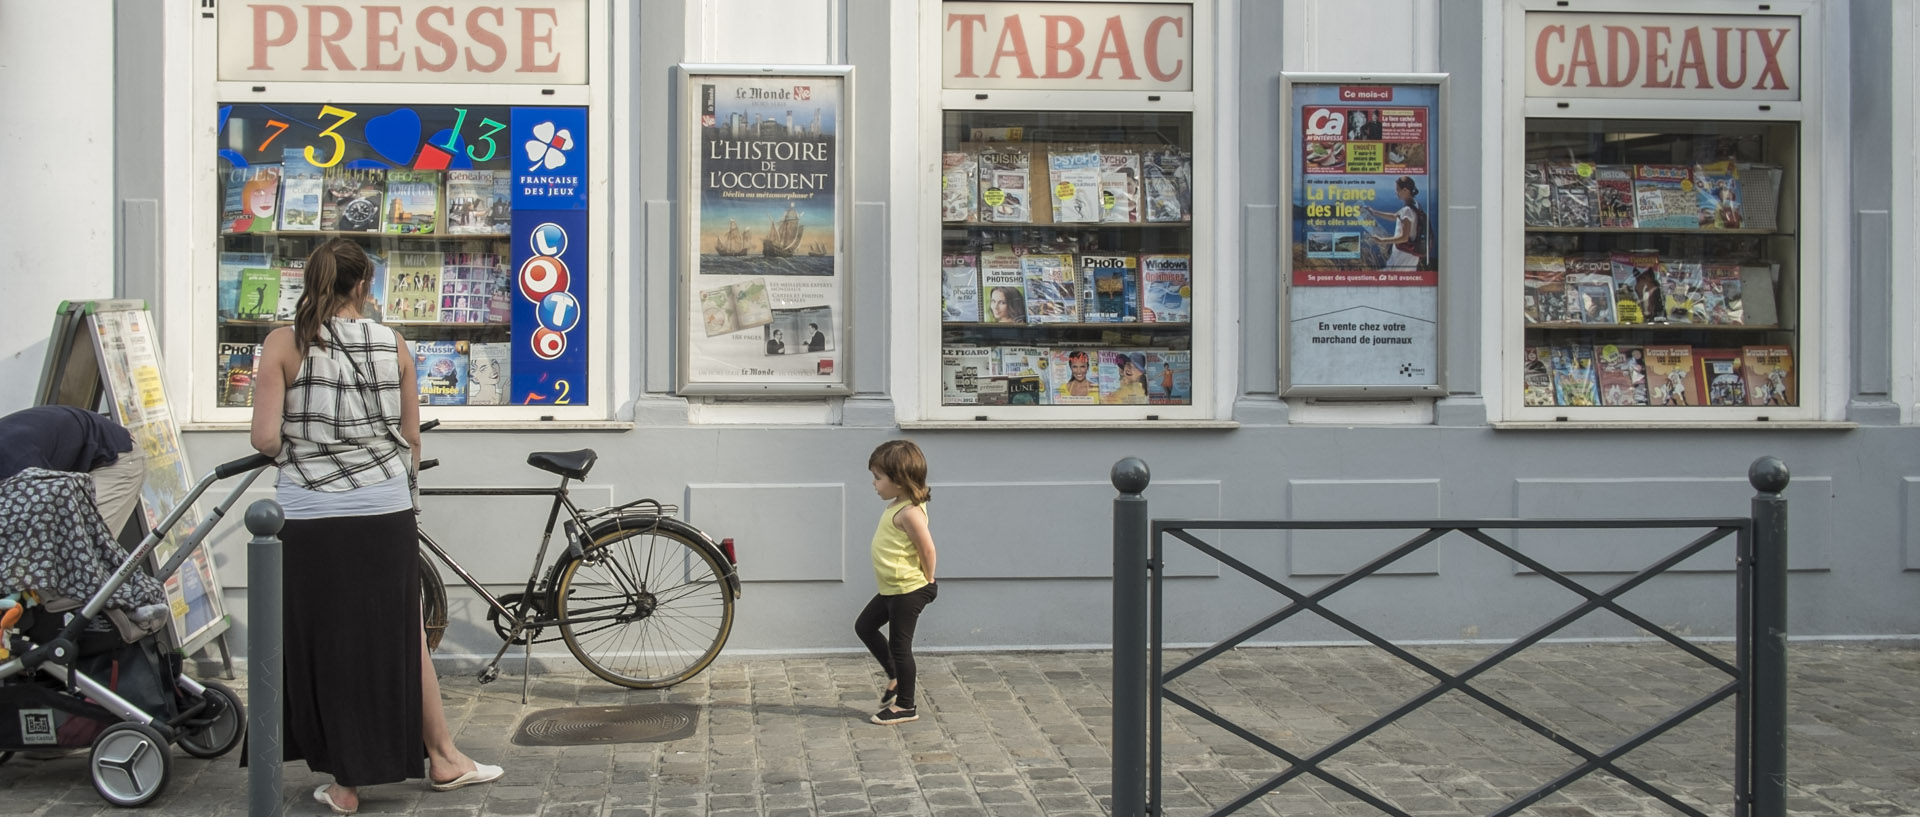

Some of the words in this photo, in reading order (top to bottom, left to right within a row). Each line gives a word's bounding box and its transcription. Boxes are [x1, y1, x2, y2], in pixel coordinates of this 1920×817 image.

[247, 4, 561, 73] PRESSE
[947, 13, 1183, 82] TABAC
[1535, 24, 1791, 90] CADEAUX
[736, 87, 747, 100] Le
[750, 87, 791, 100] Monde
[1344, 90, 1356, 98] Ce
[1358, 90, 1388, 98] mois-ci
[258, 120, 290, 152] 7
[304, 105, 357, 168] 3
[710, 140, 828, 161] L'HISTOIRE
[983, 154, 1029, 165] CUISINE
[1099, 156, 1128, 164] SYCHO
[761, 161, 776, 171] DE
[449, 171, 492, 185] Généalog
[710, 171, 828, 190] L'OCCIDENT
[524, 187, 544, 195] DES
[548, 187, 574, 196] JEUX
[723, 190, 745, 198] Déclin
[756, 191, 808, 200] métamorphose
[1307, 185, 1324, 200] La
[1328, 184, 1376, 200] France
[1307, 202, 1331, 217] des
[1335, 201, 1361, 217] îles
[1347, 219, 1376, 227] sauvages
[290, 260, 306, 268] HIST
[1084, 257, 1124, 268] PHOTO
[1145, 260, 1187, 269] Windows
[522, 228, 576, 358] LOTO
[1319, 322, 1330, 331] En
[1332, 323, 1357, 331] vente
[1359, 322, 1380, 331] chez
[1383, 323, 1406, 331] votre
[1312, 335, 1357, 344] marchand
[1360, 335, 1371, 344] de
[1372, 335, 1412, 346] journaux
[221, 344, 255, 355] PHOT
[417, 343, 454, 354] Réussir
[749, 368, 775, 376] Monde
[554, 380, 570, 404] 2
[1010, 384, 1035, 393] LUNE
[118, 543, 150, 577] Evolutwin
